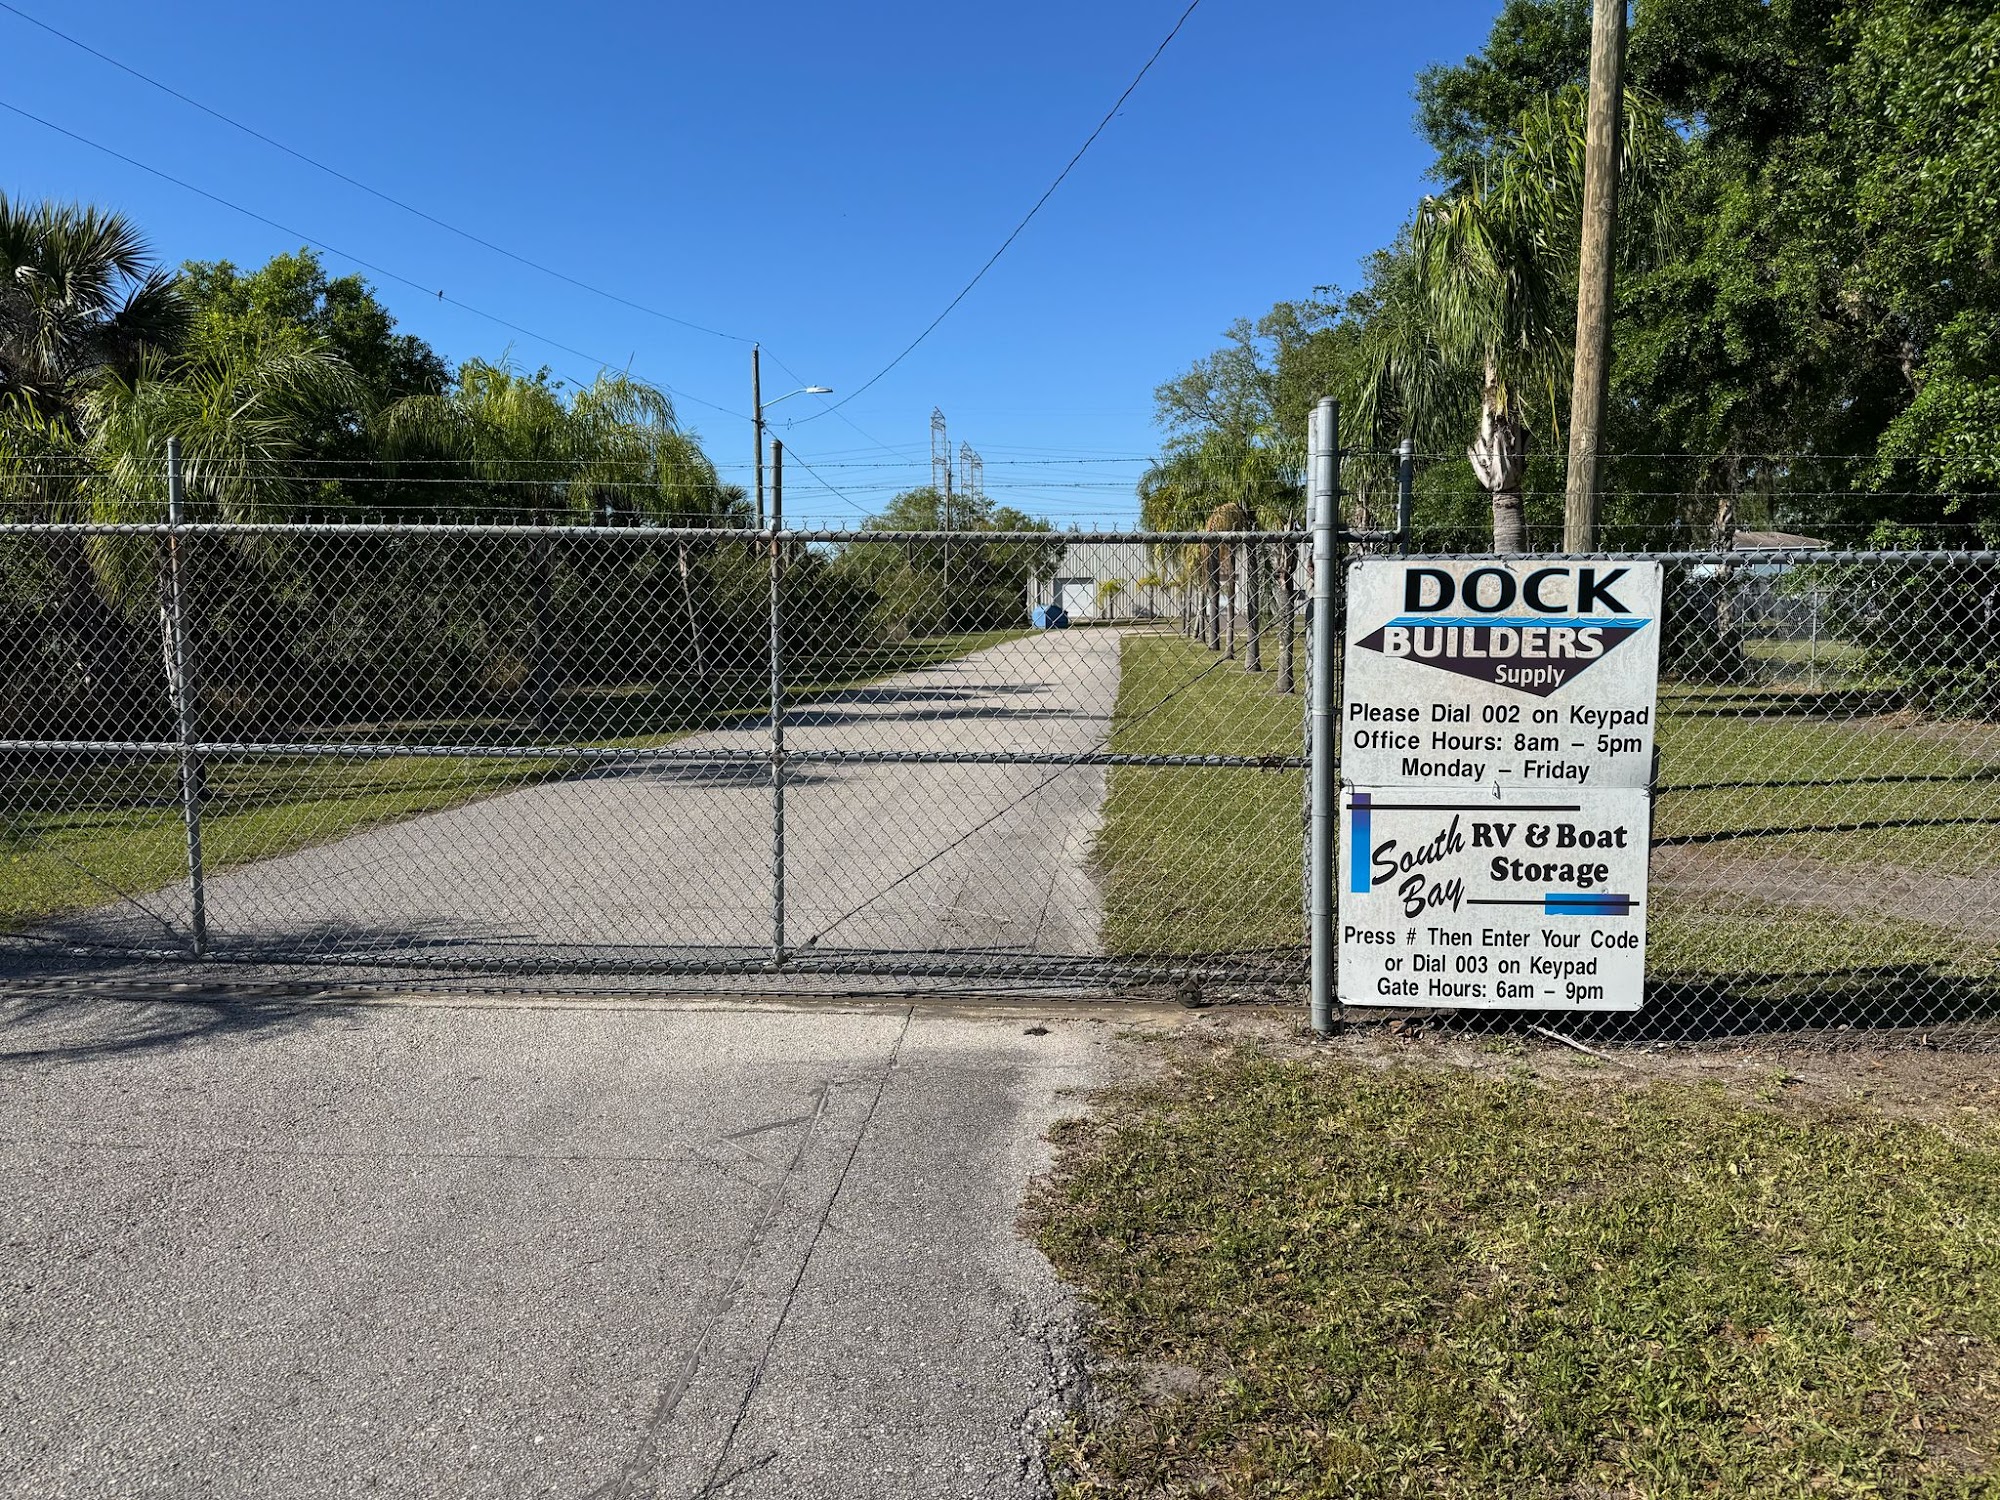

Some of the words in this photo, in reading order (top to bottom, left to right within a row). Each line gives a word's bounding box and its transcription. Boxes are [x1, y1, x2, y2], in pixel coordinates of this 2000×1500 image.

[1404, 568, 1632, 613] DOCK
[1384, 626, 1605, 659] BUILDERS
[1494, 664, 1565, 686] Supply
[1350, 703, 1419, 722] Please
[1432, 704, 1470, 722] Dial
[1483, 705, 1519, 723] 002
[1533, 710, 1557, 723] on
[1571, 705, 1648, 729] Keypad
[1354, 730, 1419, 749] Office
[1433, 732, 1501, 750] Hours:
[1514, 734, 1558, 751] 8am
[1598, 735, 1641, 757] 5pm
[1402, 758, 1485, 782] Monday
[1525, 760, 1590, 784] Friday
[1472, 823, 1516, 847] RV
[1525, 824, 1550, 848] &
[1556, 824, 1627, 848] Boat
[1371, 814, 1466, 886] South
[1491, 856, 1608, 888] Storage
[1398, 873, 1466, 919] Bay
[1345, 926, 1395, 944] Press
[1407, 928, 1416, 945] #
[1428, 928, 1471, 946] Then
[1483, 929, 1530, 947] Enter
[1542, 930, 1580, 947] Your
[1591, 930, 1638, 948] Code
[1385, 958, 1403, 971] or
[1414, 954, 1445, 972] Dial
[1456, 956, 1487, 973] 003
[1498, 960, 1519, 973] on
[1531, 956, 1596, 979] Keypad
[1378, 977, 1418, 996] Gate
[1429, 979, 1485, 997] Hours:
[1497, 981, 1533, 998] 6am
[1566, 982, 1603, 1004] 9pm
